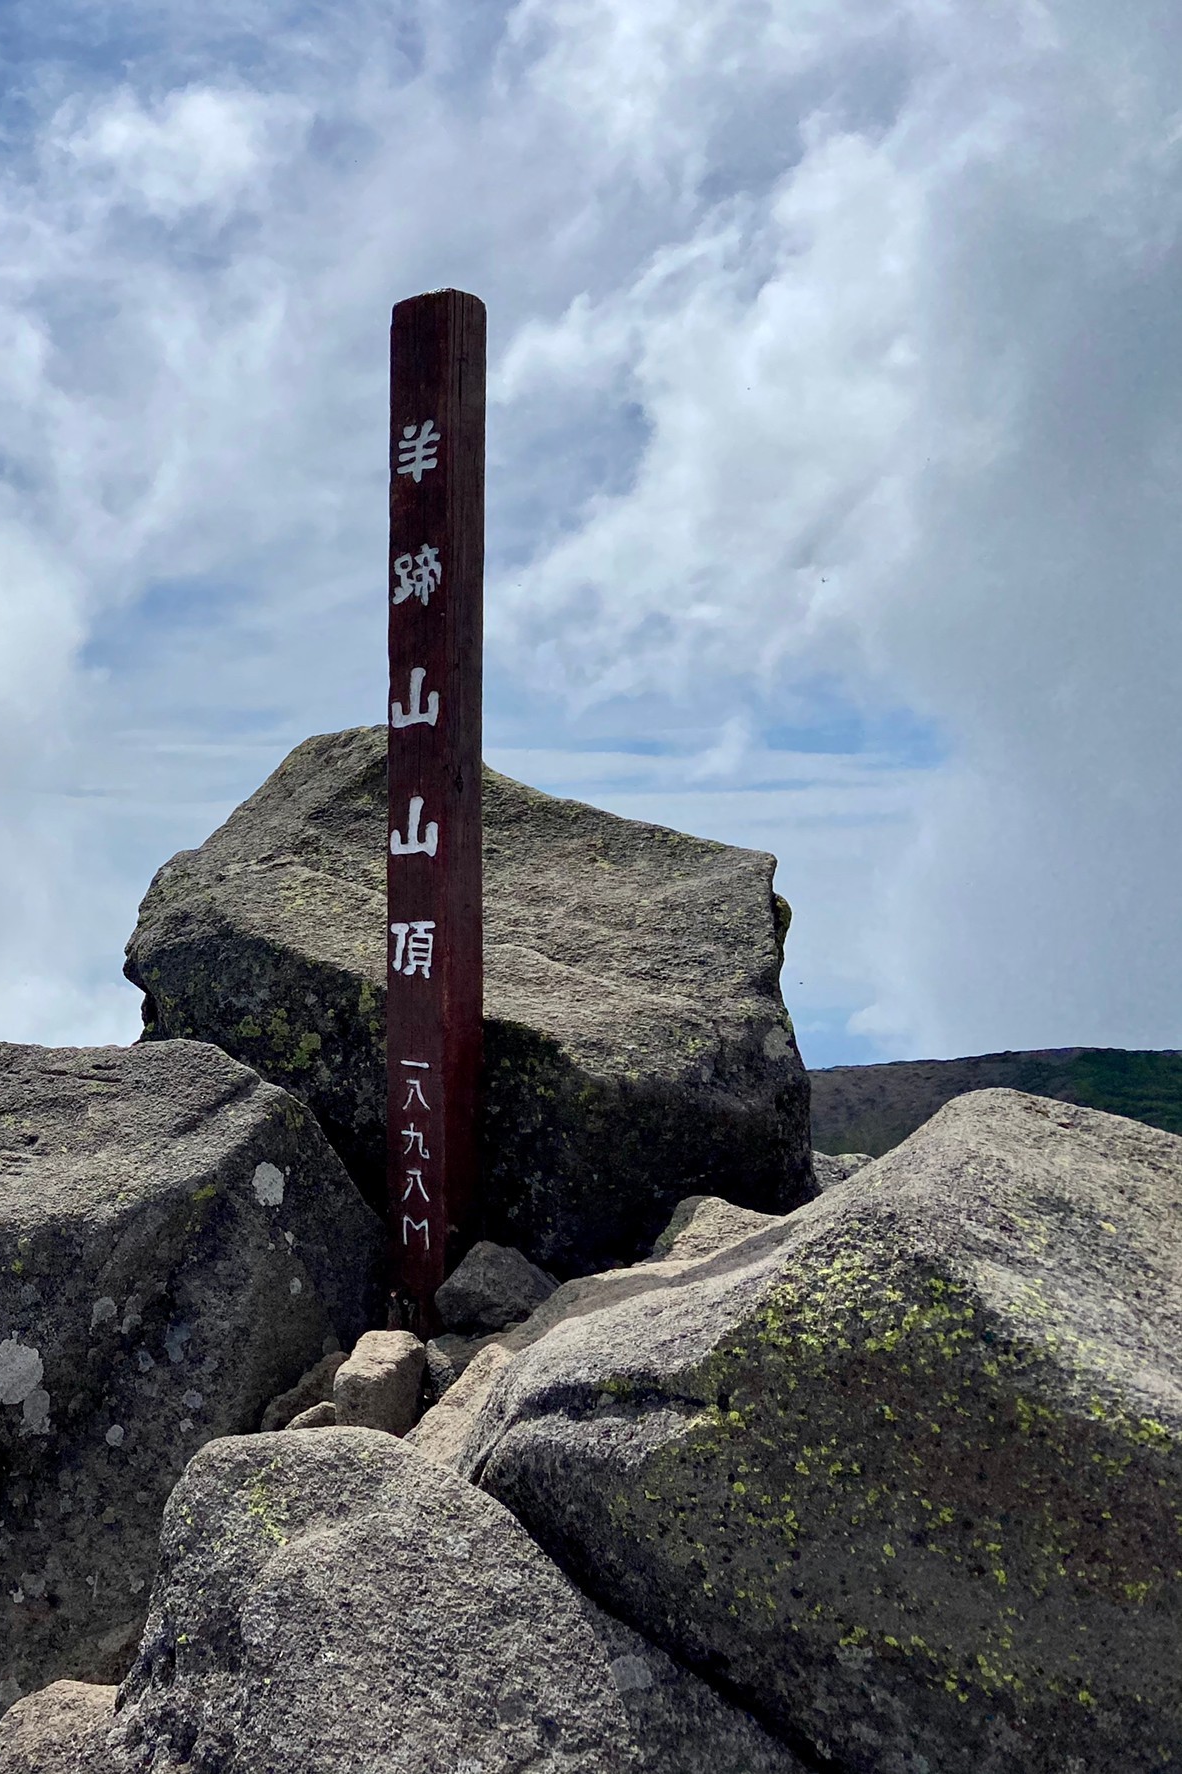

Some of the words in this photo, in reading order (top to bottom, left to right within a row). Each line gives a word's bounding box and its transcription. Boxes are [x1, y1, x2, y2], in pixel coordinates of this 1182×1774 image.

[389, 420, 443, 980] 羊蹄山山頂
